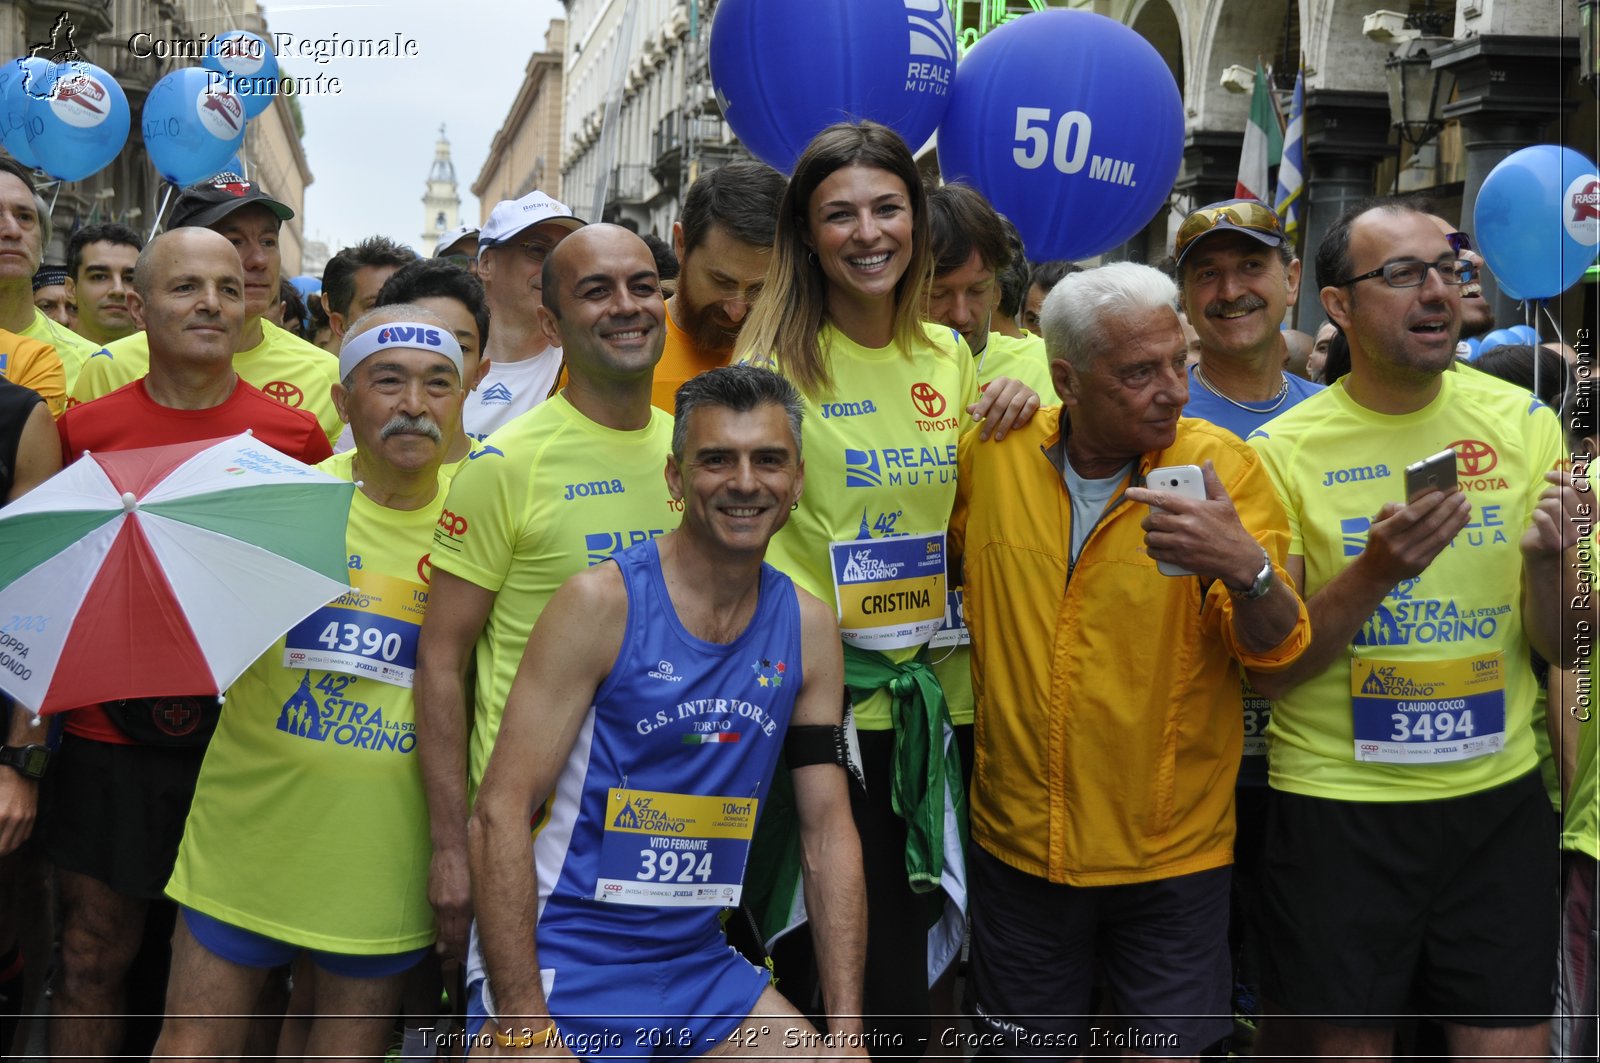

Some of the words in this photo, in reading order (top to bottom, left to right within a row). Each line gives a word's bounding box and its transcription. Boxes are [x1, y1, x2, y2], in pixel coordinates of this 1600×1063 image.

[908, 63, 950, 84] REALE
[905, 80, 947, 97] MUTUA
[1012, 107, 1092, 174] 50
[1089, 155, 1137, 187] MIN.
[523, 202, 549, 213] Rotary
[378, 327, 441, 346] AVIS
[915, 417, 959, 432] TOYOTA
[882, 445, 957, 468] REALE
[872, 510, 902, 534] 42°
[860, 559, 885, 571] STRA
[862, 567, 898, 580] TORINO
[933, 577, 937, 586] 7
[862, 589, 930, 615] CRISTINA
[1395, 598, 1459, 622] STRA
[1461, 610, 1476, 618] LA
[1478, 604, 1511, 617] STAMPA
[1397, 617, 1497, 645] TORINO
[318, 621, 402, 661] 4390
[1471, 659, 1498, 672] 10km
[648, 670, 682, 682] GENCHY
[1383, 677, 1413, 686] STRA
[315, 673, 357, 697] 42°
[1385, 686, 1434, 696] TORINO
[321, 698, 383, 728] STRA
[1397, 701, 1437, 712] CLAUDIO
[1437, 699, 1465, 711] COCCO
[636, 710, 674, 735] G.S.
[1391, 709, 1474, 741] 3494
[322, 720, 416, 754] TORINO
[638, 808, 667, 820] STRA
[722, 803, 750, 815] 10km
[639, 819, 685, 833] TORINO
[650, 837, 670, 849] VITO
[671, 838, 708, 851] FERRANTE
[636, 849, 712, 882] 3924
